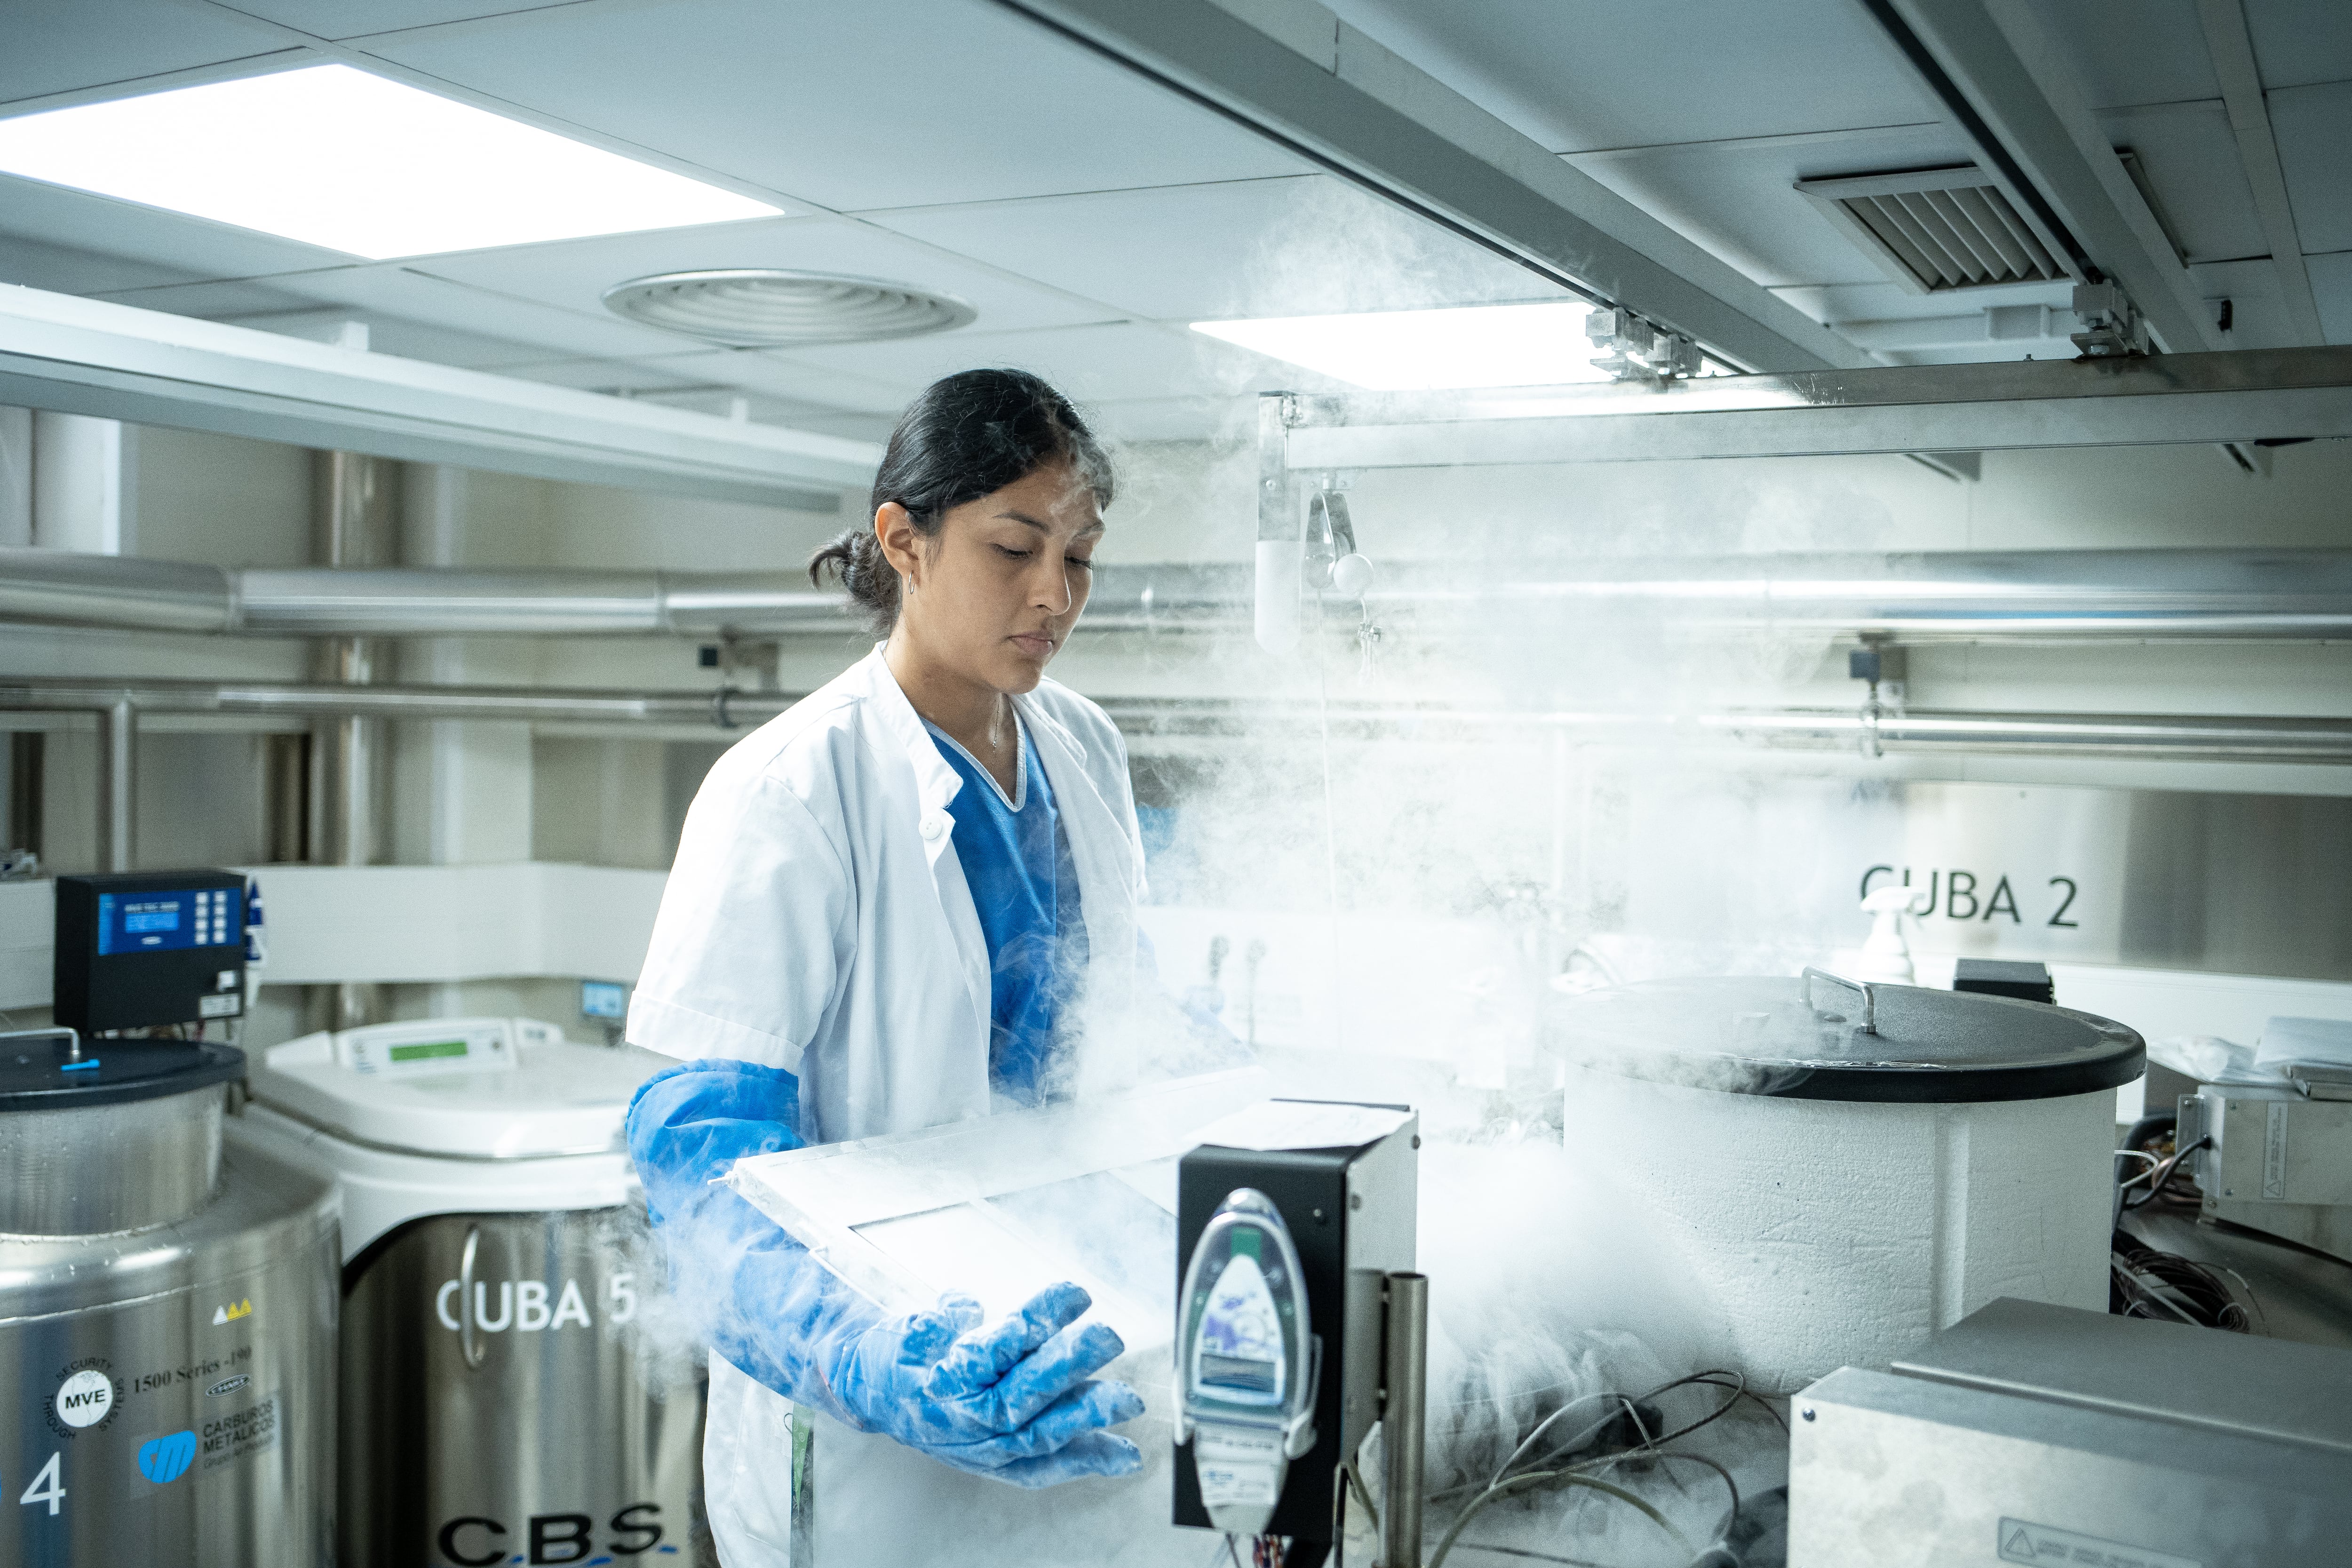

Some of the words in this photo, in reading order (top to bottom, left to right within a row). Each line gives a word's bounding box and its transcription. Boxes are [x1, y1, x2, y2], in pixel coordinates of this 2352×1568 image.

[1860, 864, 2021, 923] CUBA
[2048, 876, 2078, 926] 2
[436, 1278, 591, 1332] CUBA
[611, 1272, 636, 1323] 5
[56, 1357, 113, 1381] SECURITY
[134, 1371, 171, 1393] 1500
[176, 1359, 220, 1382] Series
[43, 1393, 77, 1440] THROUGH
[65, 1389, 106, 1409] MVE
[98, 1377, 125, 1432] SYSTEMS
[20, 1451, 66, 1515] 4
